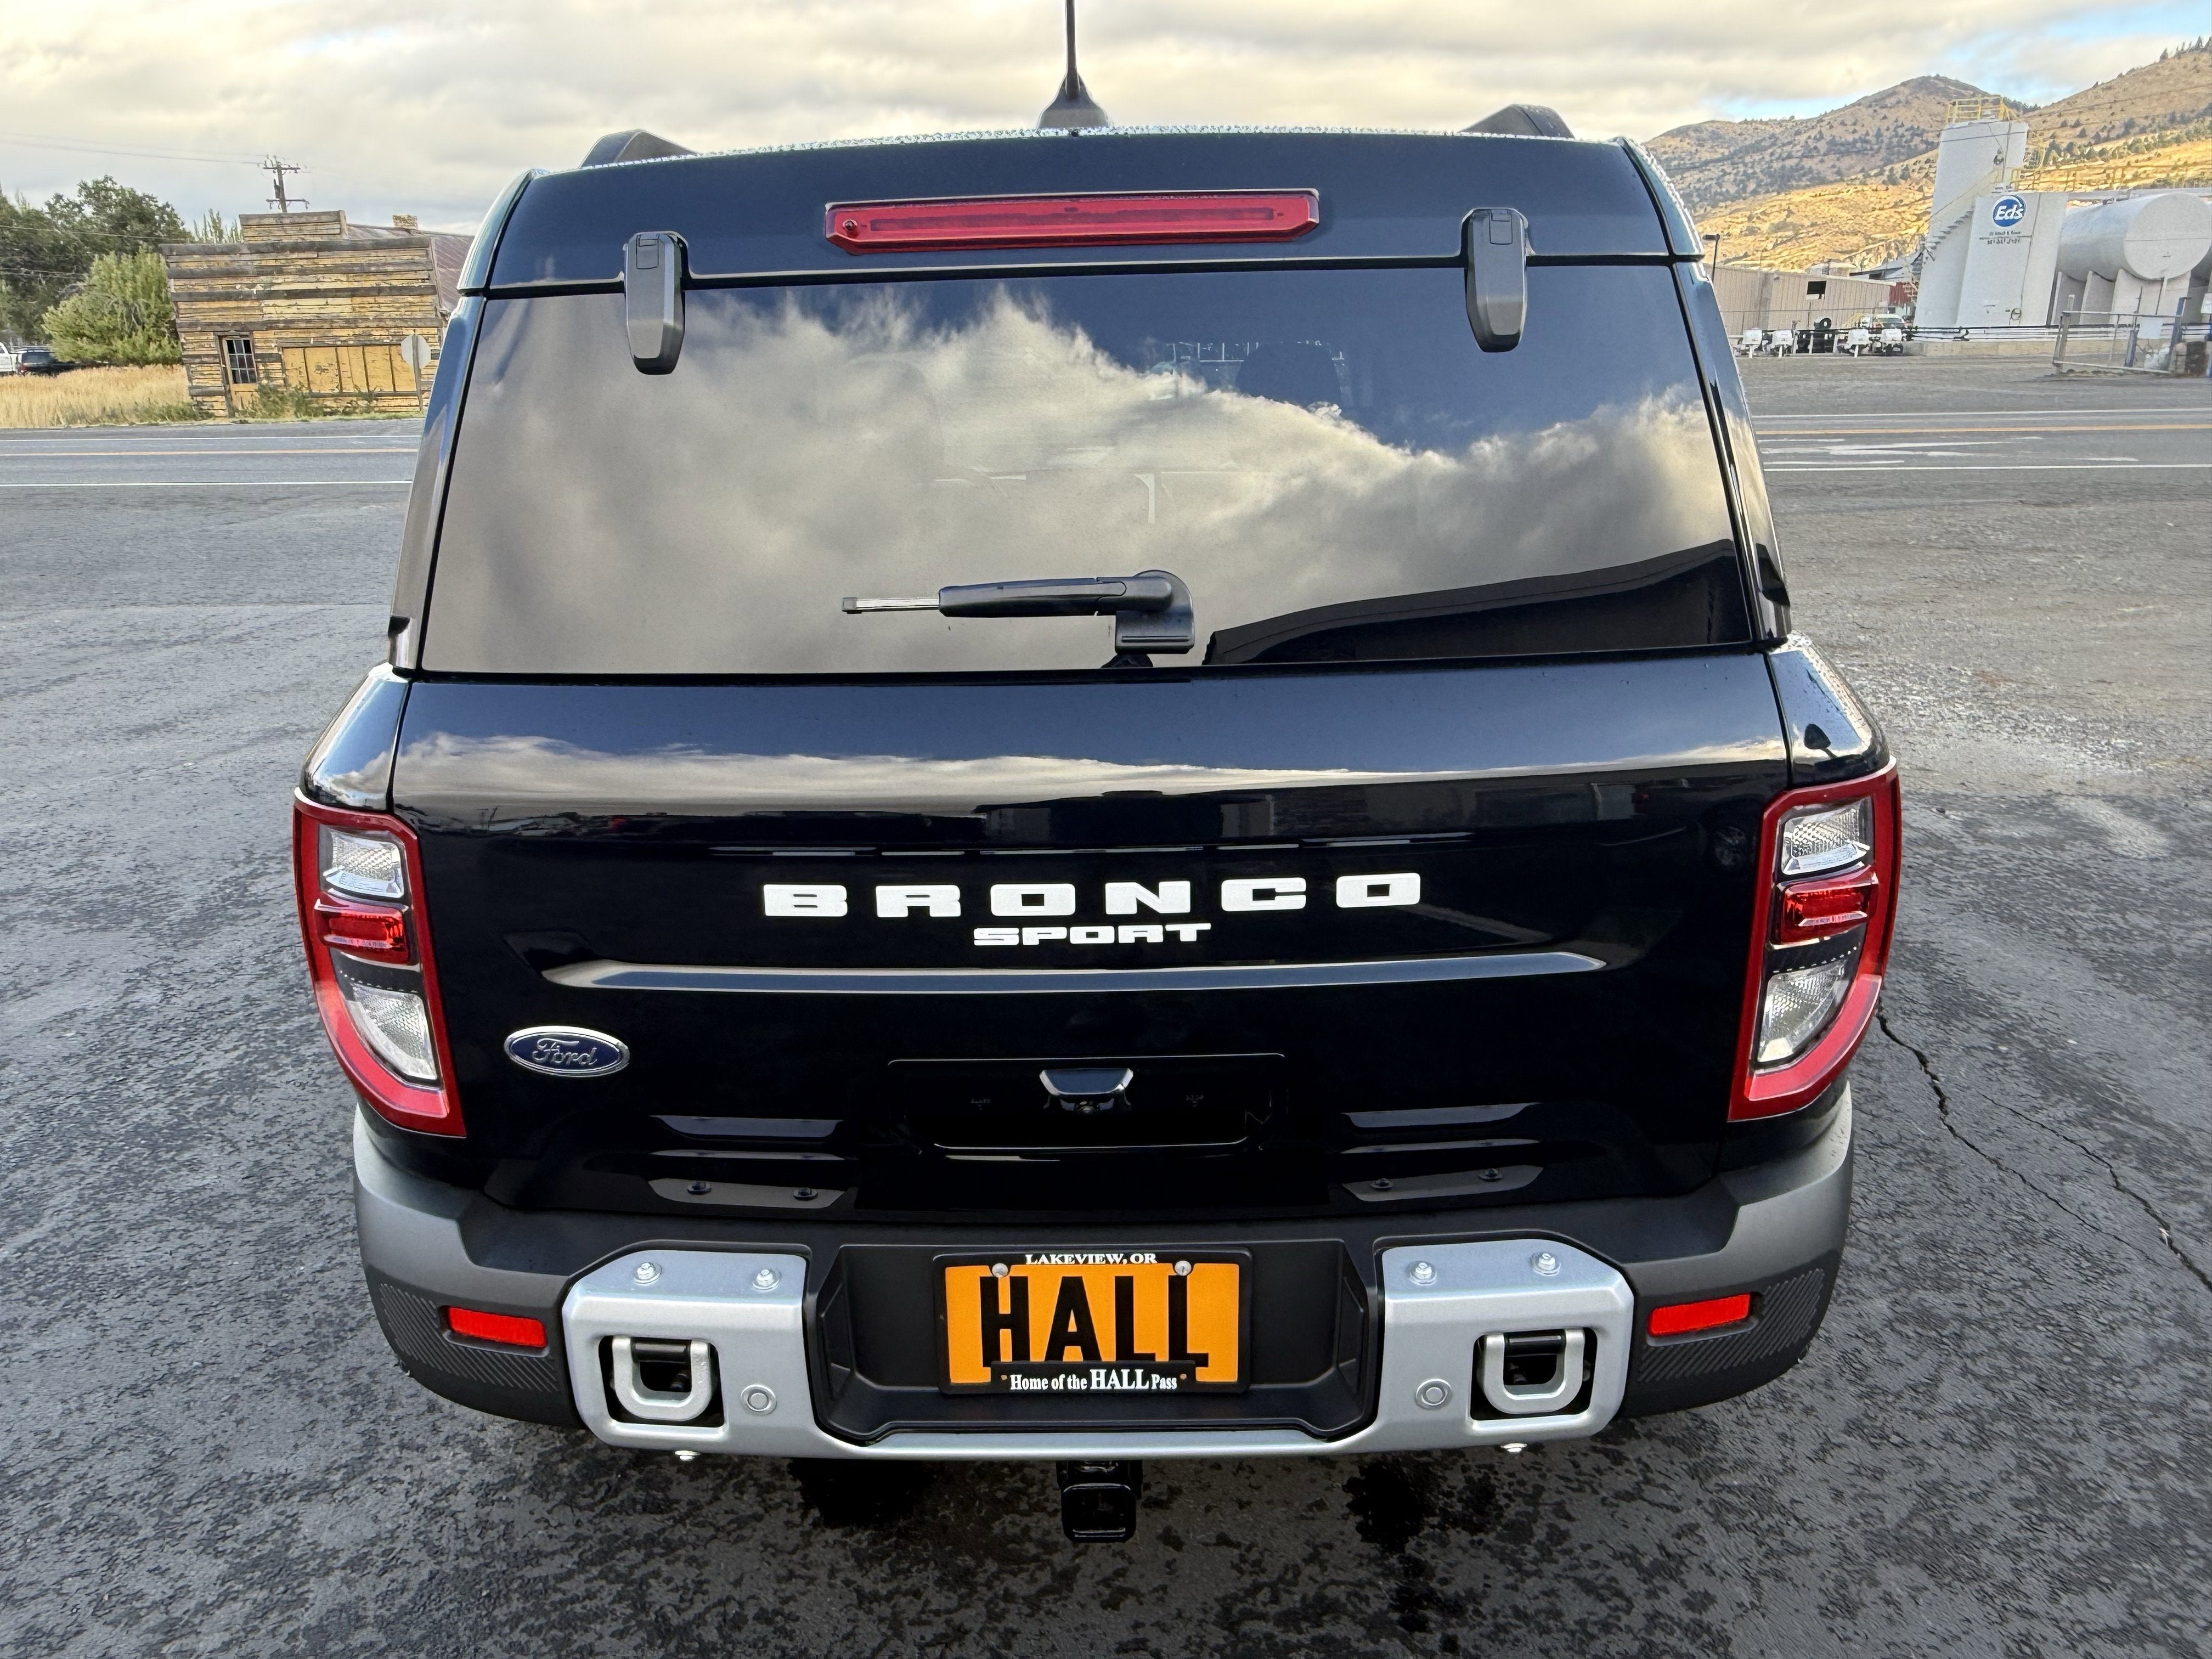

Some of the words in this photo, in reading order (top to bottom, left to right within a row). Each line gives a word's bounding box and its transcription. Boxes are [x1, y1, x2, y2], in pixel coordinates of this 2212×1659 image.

[763, 872, 1421, 918] BRONCO
[973, 923, 1211, 946] SPORT
[532, 1037, 597, 1065] Ford
[1025, 1253, 1127, 1265] LAKEVIEW,
[1130, 1253, 1158, 1264] OR
[979, 1275, 1209, 1368] HALL
[1010, 1374, 1048, 1390] Home
[1051, 1374, 1065, 1390] of
[1066, 1374, 1087, 1390] the
[1090, 1369, 1149, 1390] HALL
[1151, 1374, 1177, 1390] Pass
